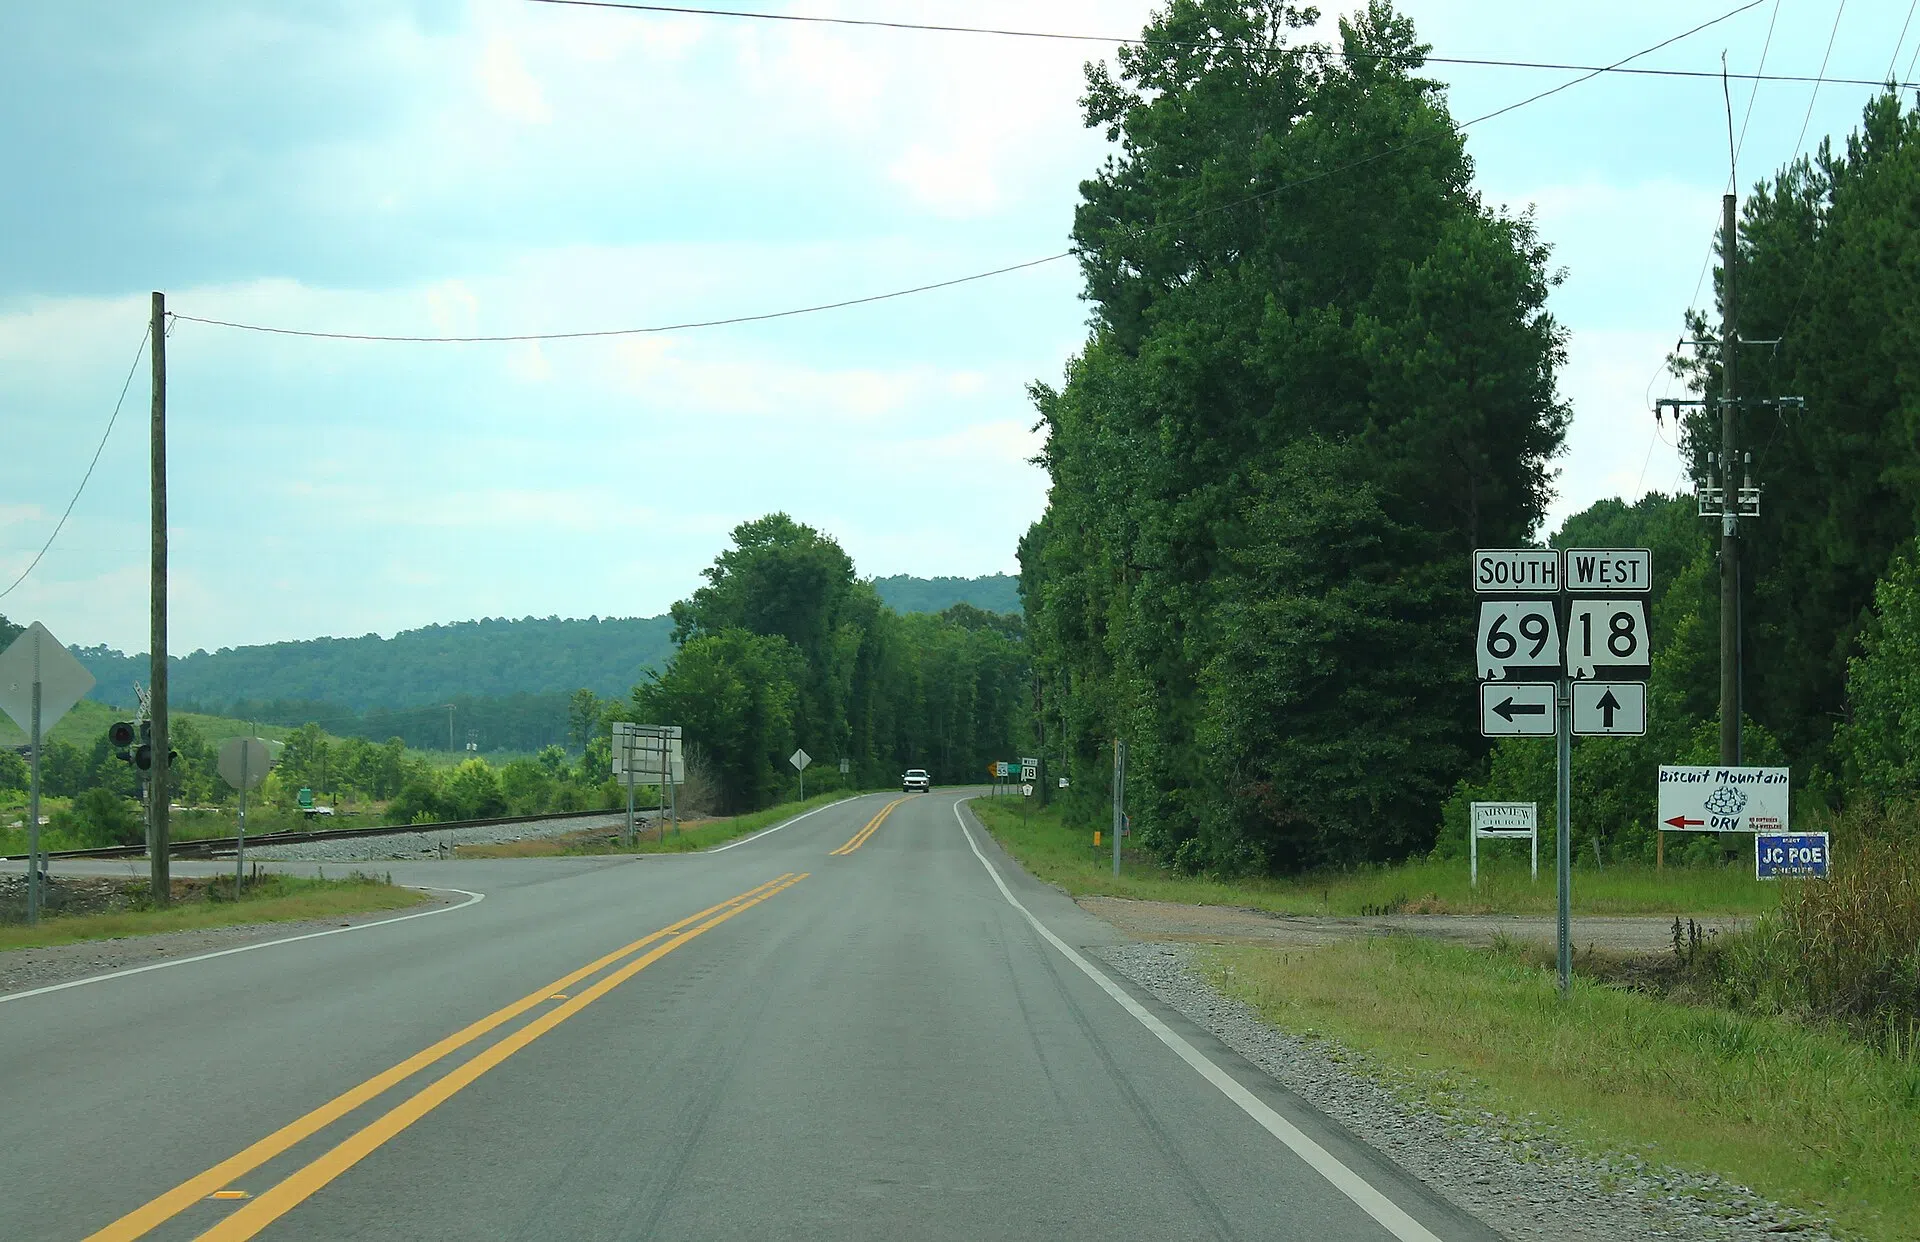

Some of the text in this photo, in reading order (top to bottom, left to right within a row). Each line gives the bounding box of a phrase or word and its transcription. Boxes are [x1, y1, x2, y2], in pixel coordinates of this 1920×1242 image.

[1479, 557, 1556, 584] SOUTH
[1575, 556, 1640, 583] WEST
[1486, 613, 1550, 660] 69
[1579, 611, 1638, 658] 18
[1024, 768, 1034, 777] 18
[1659, 769, 1788, 784] Biscuit Mountain
[1477, 807, 1530, 820] FAIRVIEW
[1710, 816, 1740, 830] ORV
[1762, 848, 1822, 864] JC POE
